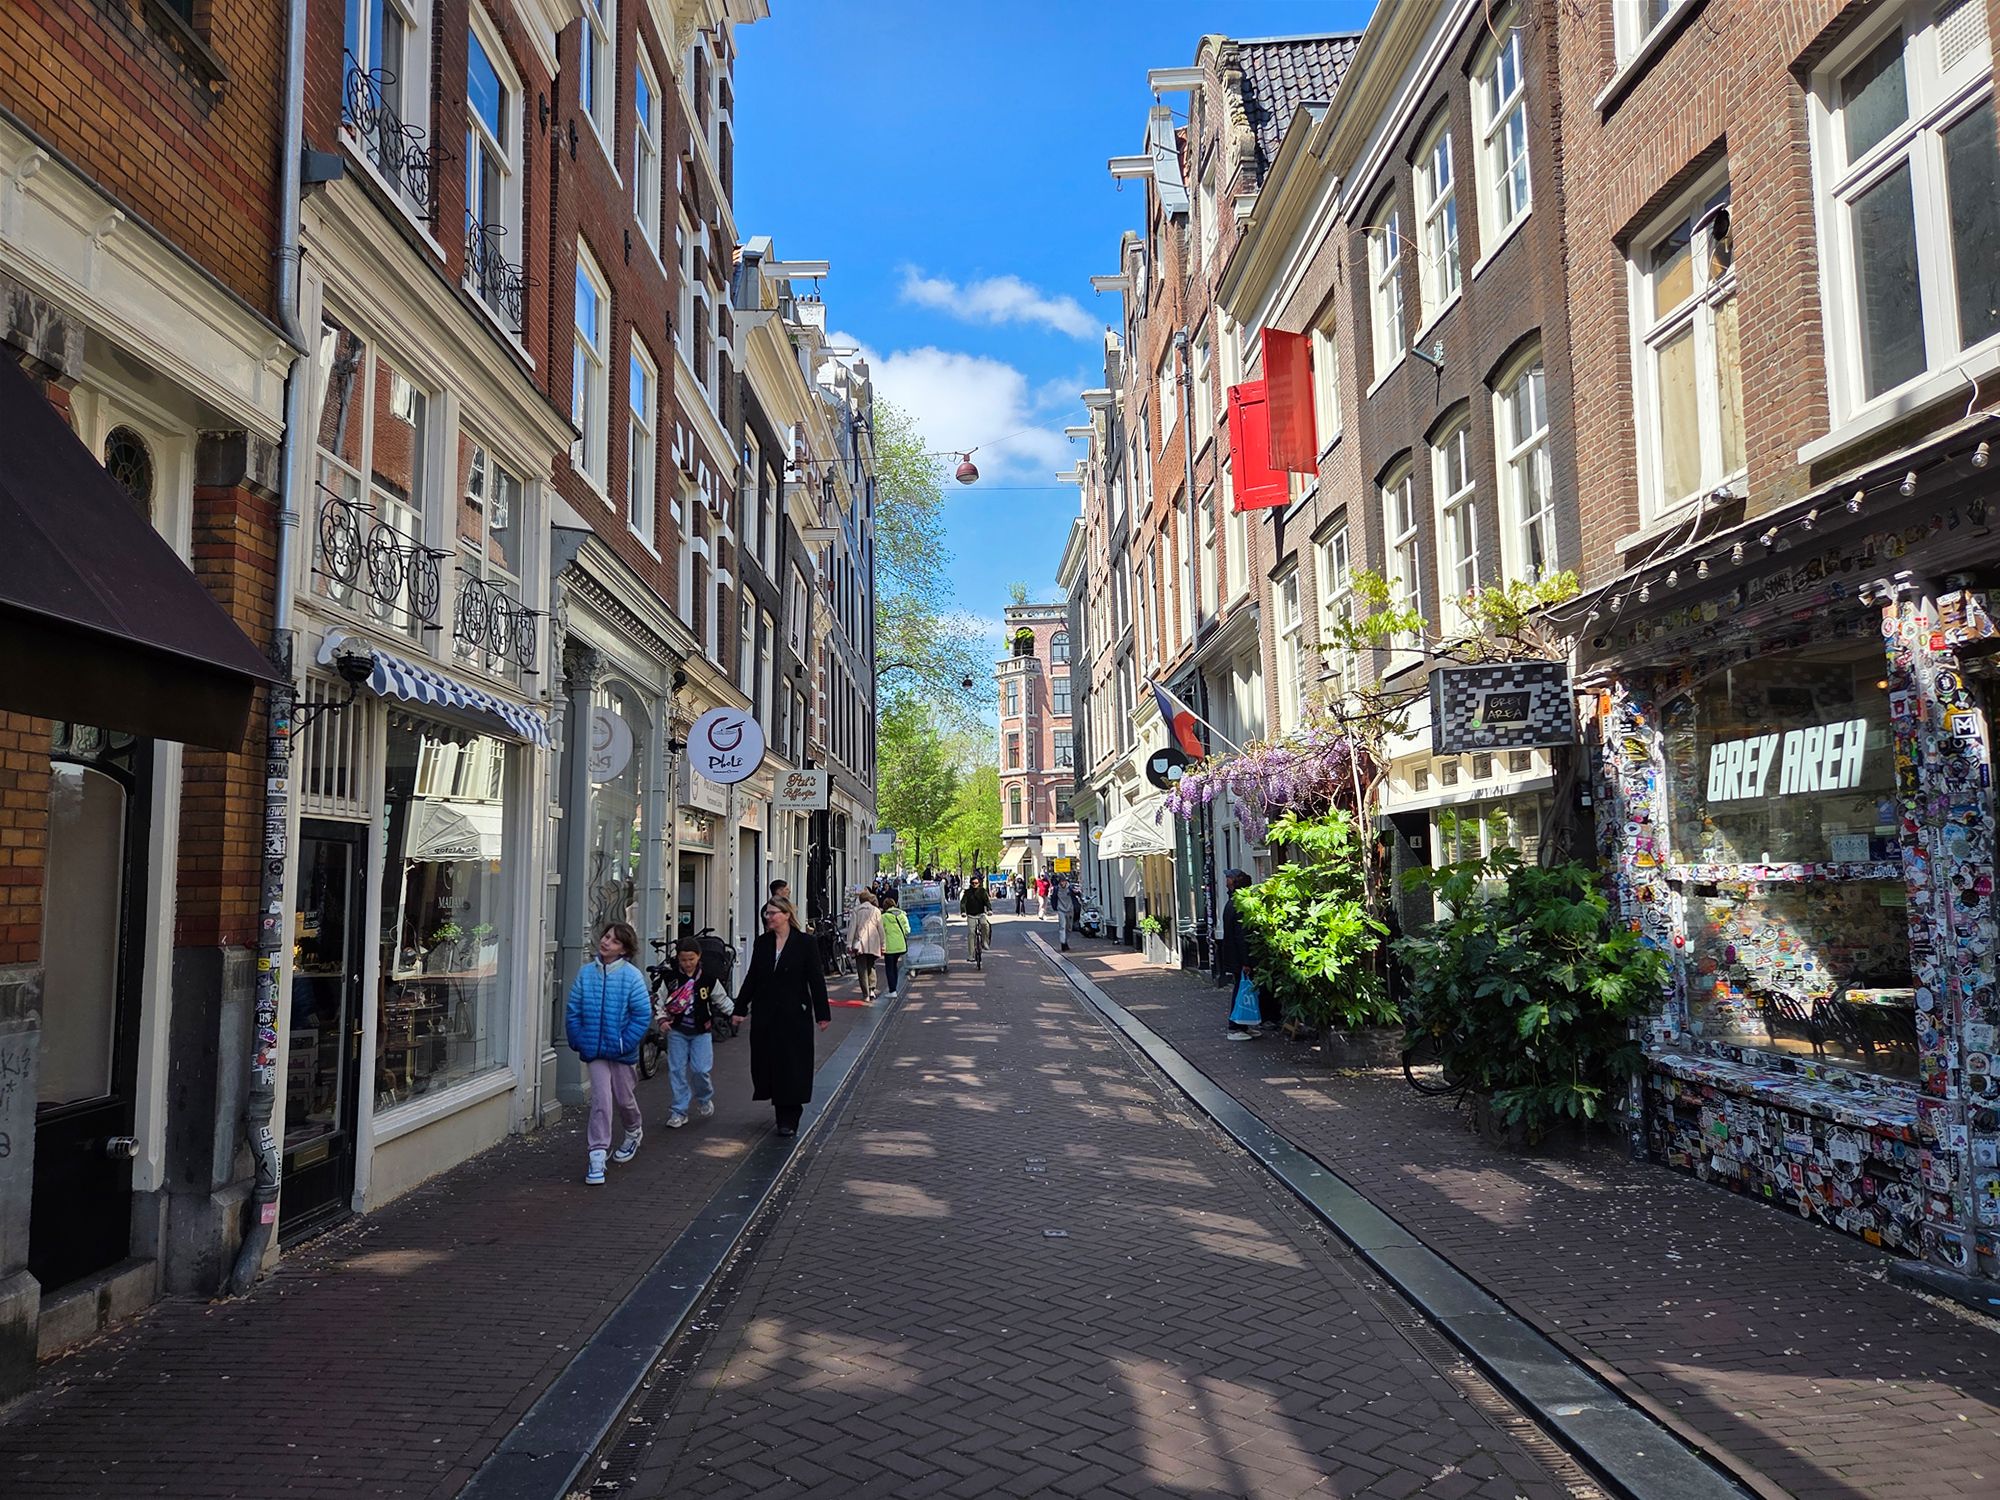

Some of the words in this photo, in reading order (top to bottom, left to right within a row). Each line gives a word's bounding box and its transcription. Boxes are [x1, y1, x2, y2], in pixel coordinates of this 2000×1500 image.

[1490, 696, 1522, 708] GREY
[1487, 708, 1522, 720] AREA
[1706, 733, 1780, 802] GREY
[1779, 718, 1867, 795] AREA
